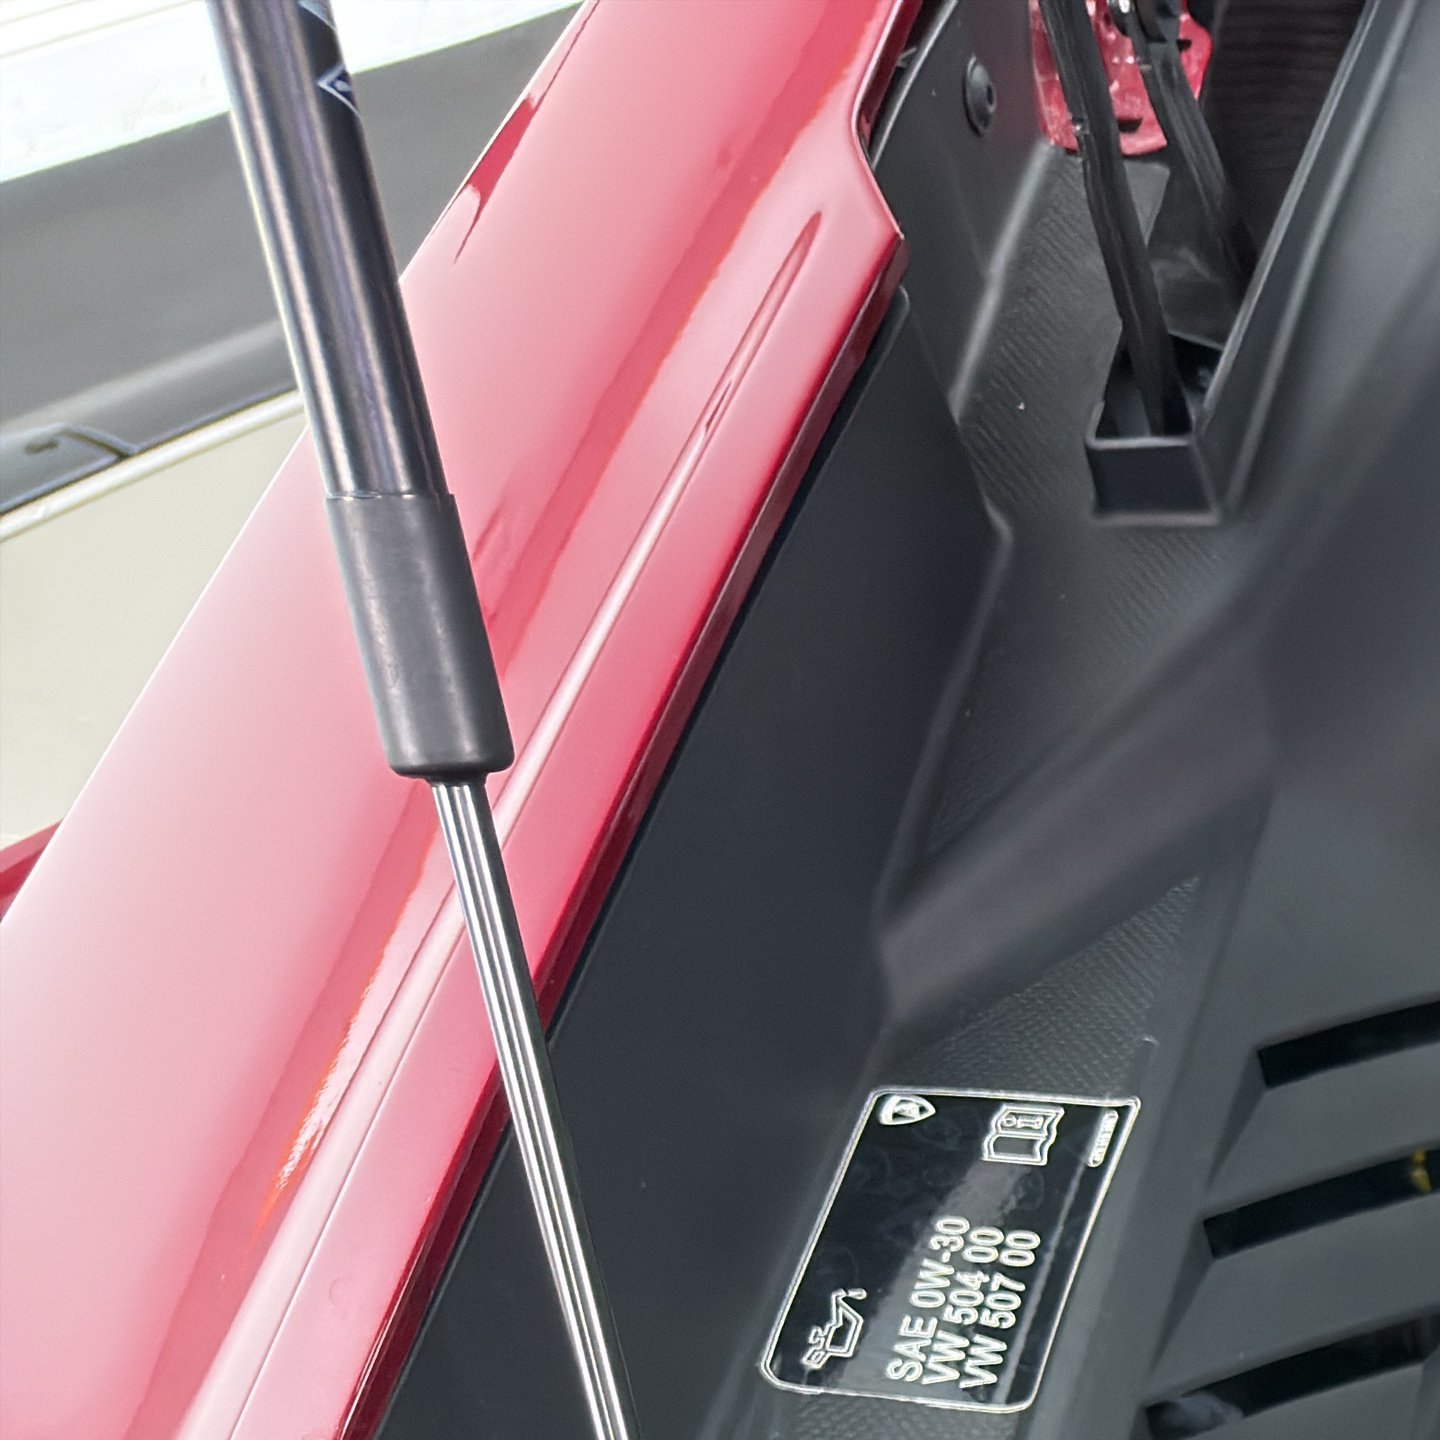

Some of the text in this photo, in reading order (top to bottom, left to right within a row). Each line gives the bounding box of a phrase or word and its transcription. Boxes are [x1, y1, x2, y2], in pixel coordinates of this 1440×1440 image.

[886, 1216, 970, 1383] SAE 0W-30
[921, 1226, 1005, 1386] VW 504 00
[959, 1230, 1041, 1389] VW 507 00
